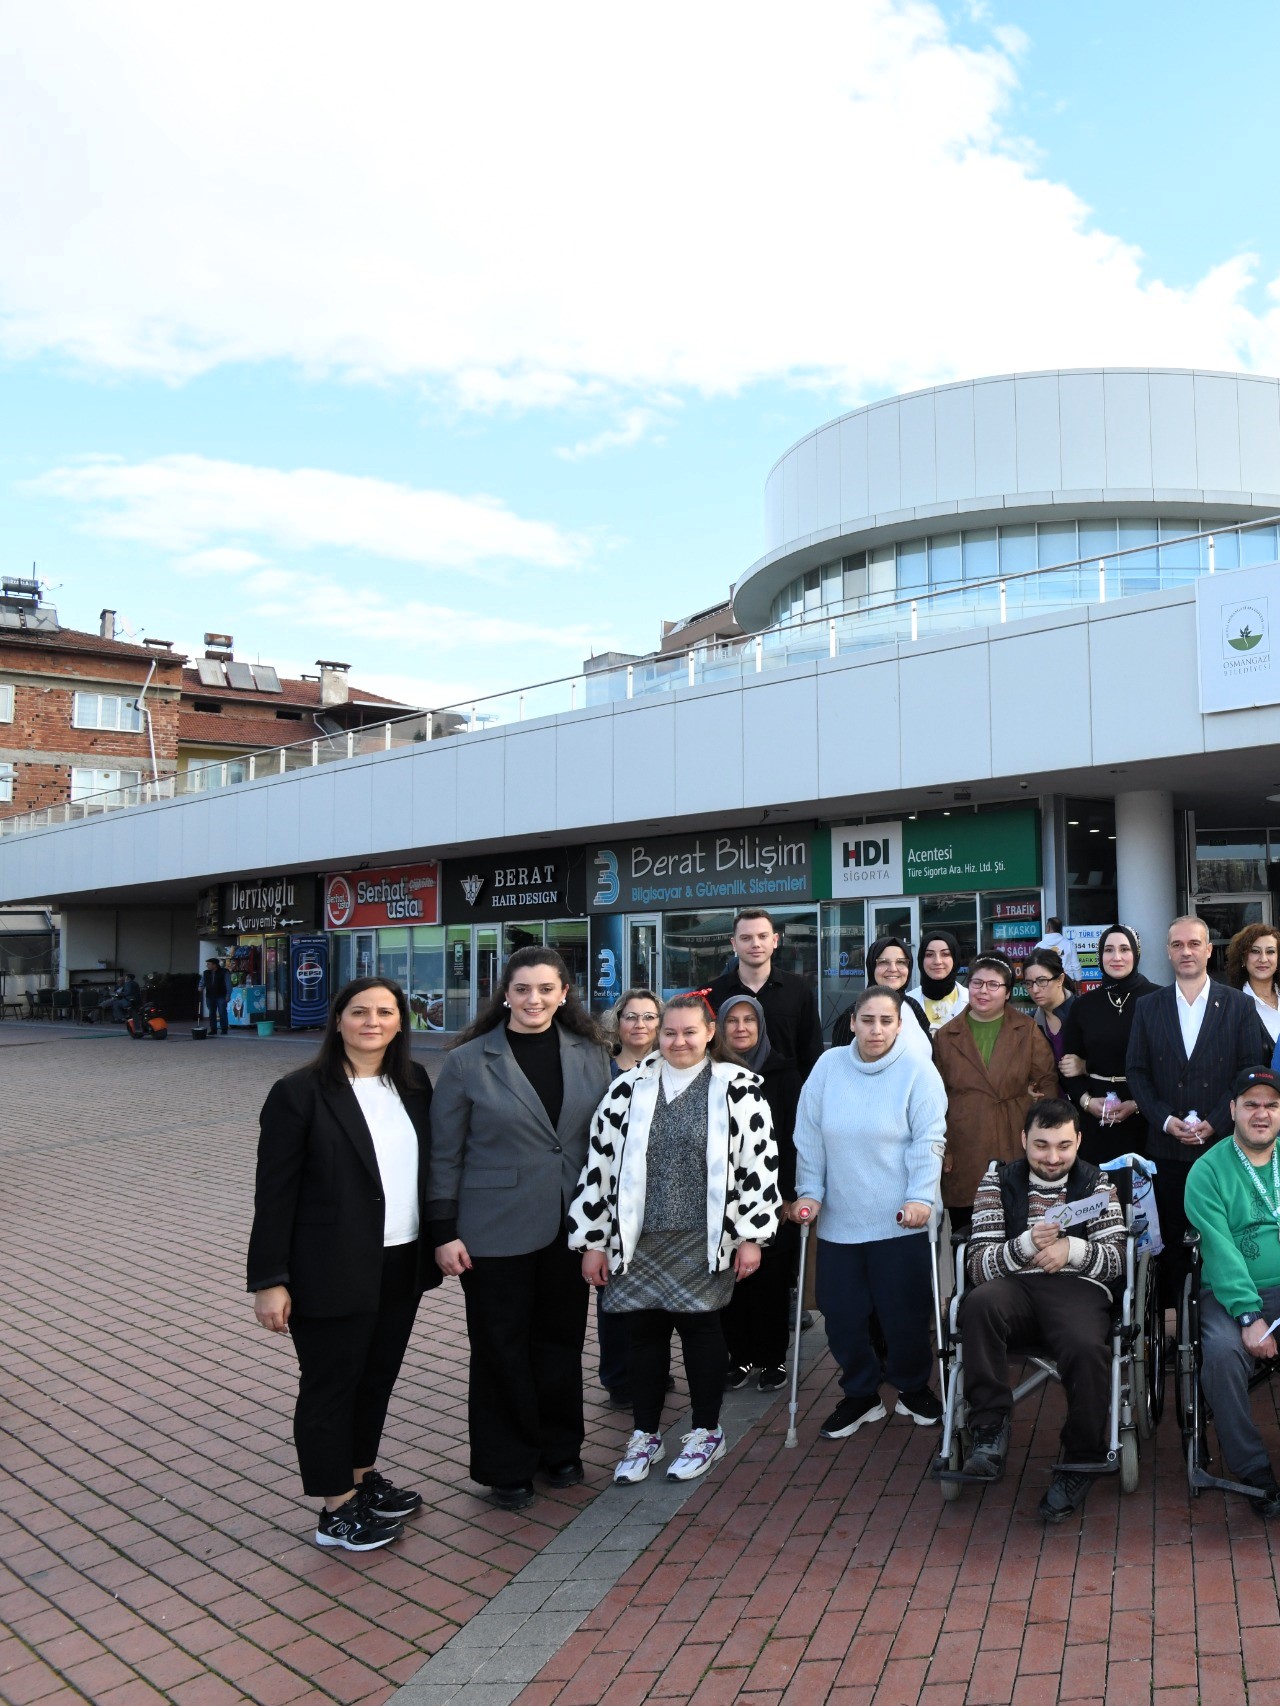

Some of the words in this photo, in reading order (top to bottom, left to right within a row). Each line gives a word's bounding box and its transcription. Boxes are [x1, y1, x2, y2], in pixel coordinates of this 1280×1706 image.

[631, 840, 705, 878] Berat
[716, 835, 806, 875] Bilişim
[843, 838, 890, 868] HDI
[908, 845, 953, 863] Acentesi
[494, 865, 555, 888] BERAT
[843, 869, 890, 882] SİGORTA
[908, 867, 923, 878] Türe
[924, 866, 947, 879] Sigorta
[949, 865, 963, 875] Ara.
[964, 863, 977, 873] Hiz.
[979, 862, 993, 873] Ltd.
[994, 861, 1006, 874] Şti.
[232, 877, 294, 916] Dervişoğlu
[357, 877, 405, 904] Serhat
[631, 886, 683, 904] Bilgisayar
[685, 886, 693, 898] &
[695, 880, 747, 898] Güvenlik
[750, 875, 807, 893] Sistemleri
[491, 894, 518, 907] HAIR
[518, 891, 558, 905] DESIGN
[1005, 902, 1036, 915] TRAFİK
[236, 915, 277, 932] Kuruyemiş
[1008, 925, 1037, 936] KASKO
[1012, 986, 1029, 997] DAS
[1074, 1201, 1103, 1217] OBAM
